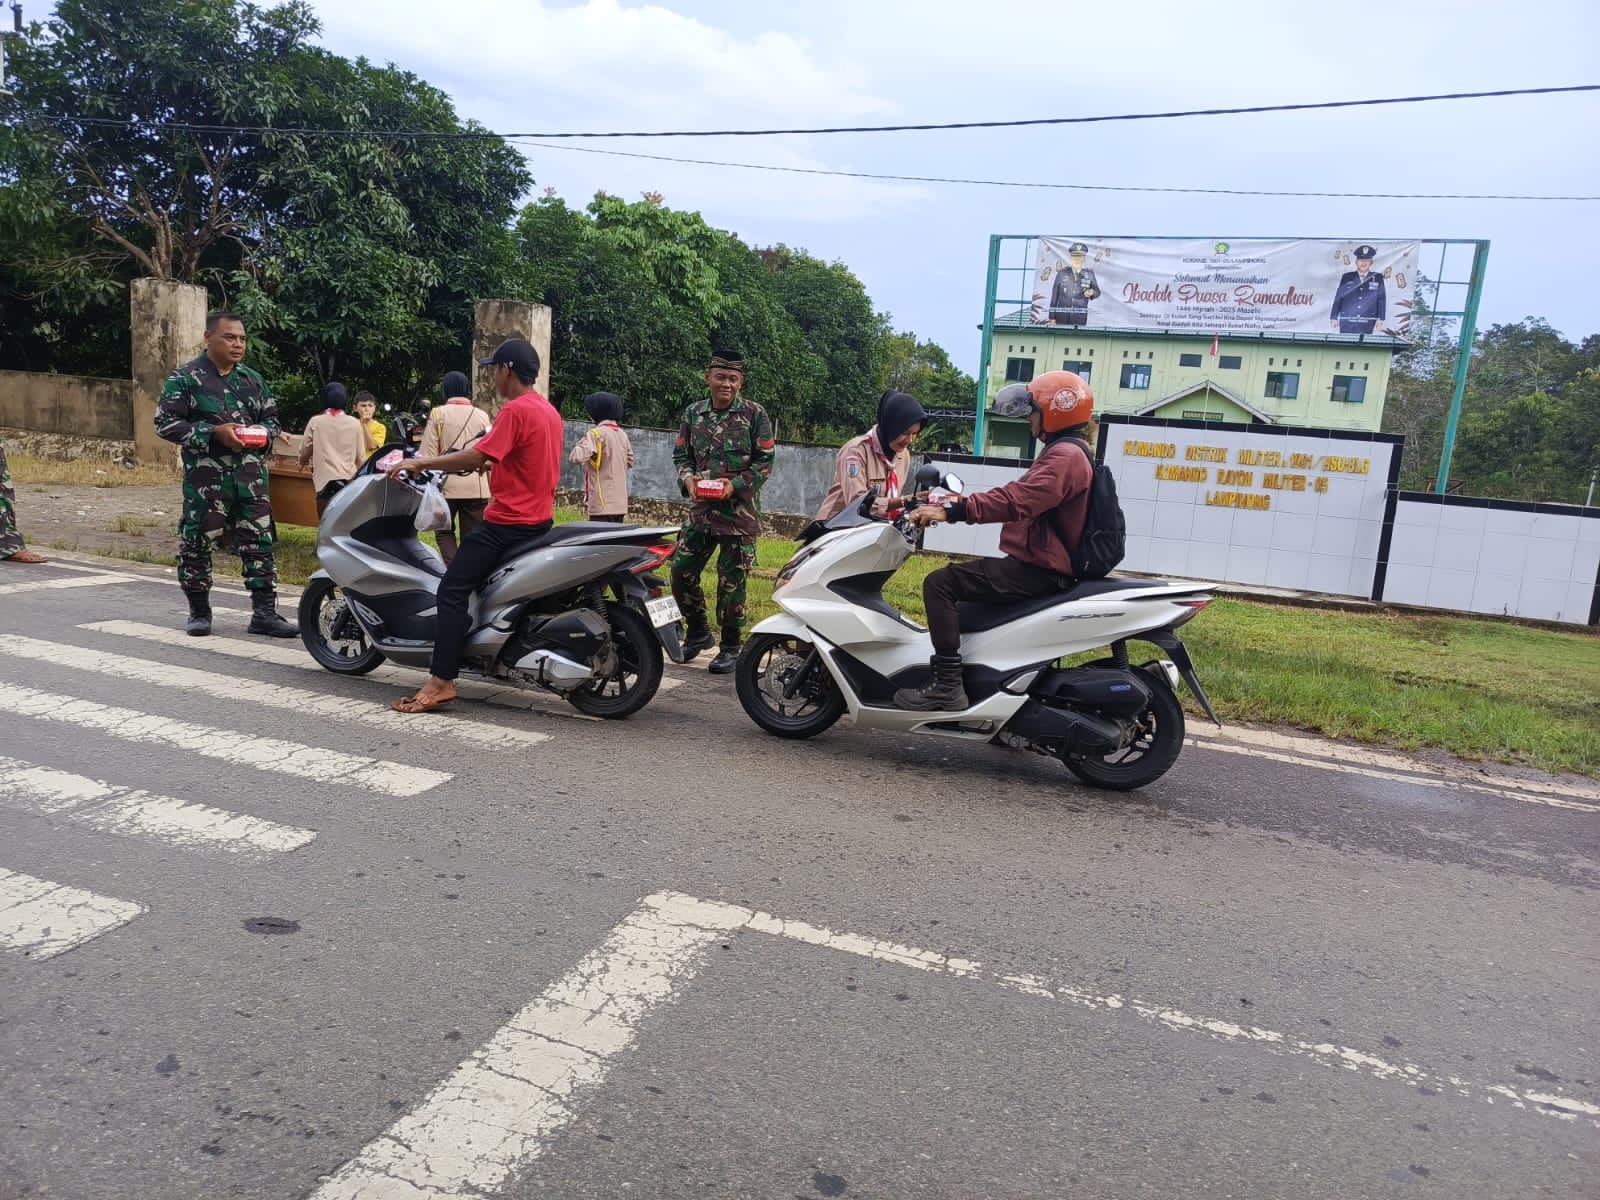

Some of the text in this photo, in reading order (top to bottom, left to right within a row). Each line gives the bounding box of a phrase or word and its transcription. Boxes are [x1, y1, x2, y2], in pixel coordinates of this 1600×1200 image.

[1173, 272, 1269, 284] Selamat Menunaikan
[1122, 282, 1314, 307] Ibadah Puasa Ramadhan
[1123, 440, 1176, 459] KOMANDO
[1185, 446, 1228, 463] DISTRIK
[1155, 464, 1208, 482] KOMANDO
[1217, 468, 1253, 487] RAYON
[1205, 490, 1271, 511] LAMPIHONG
